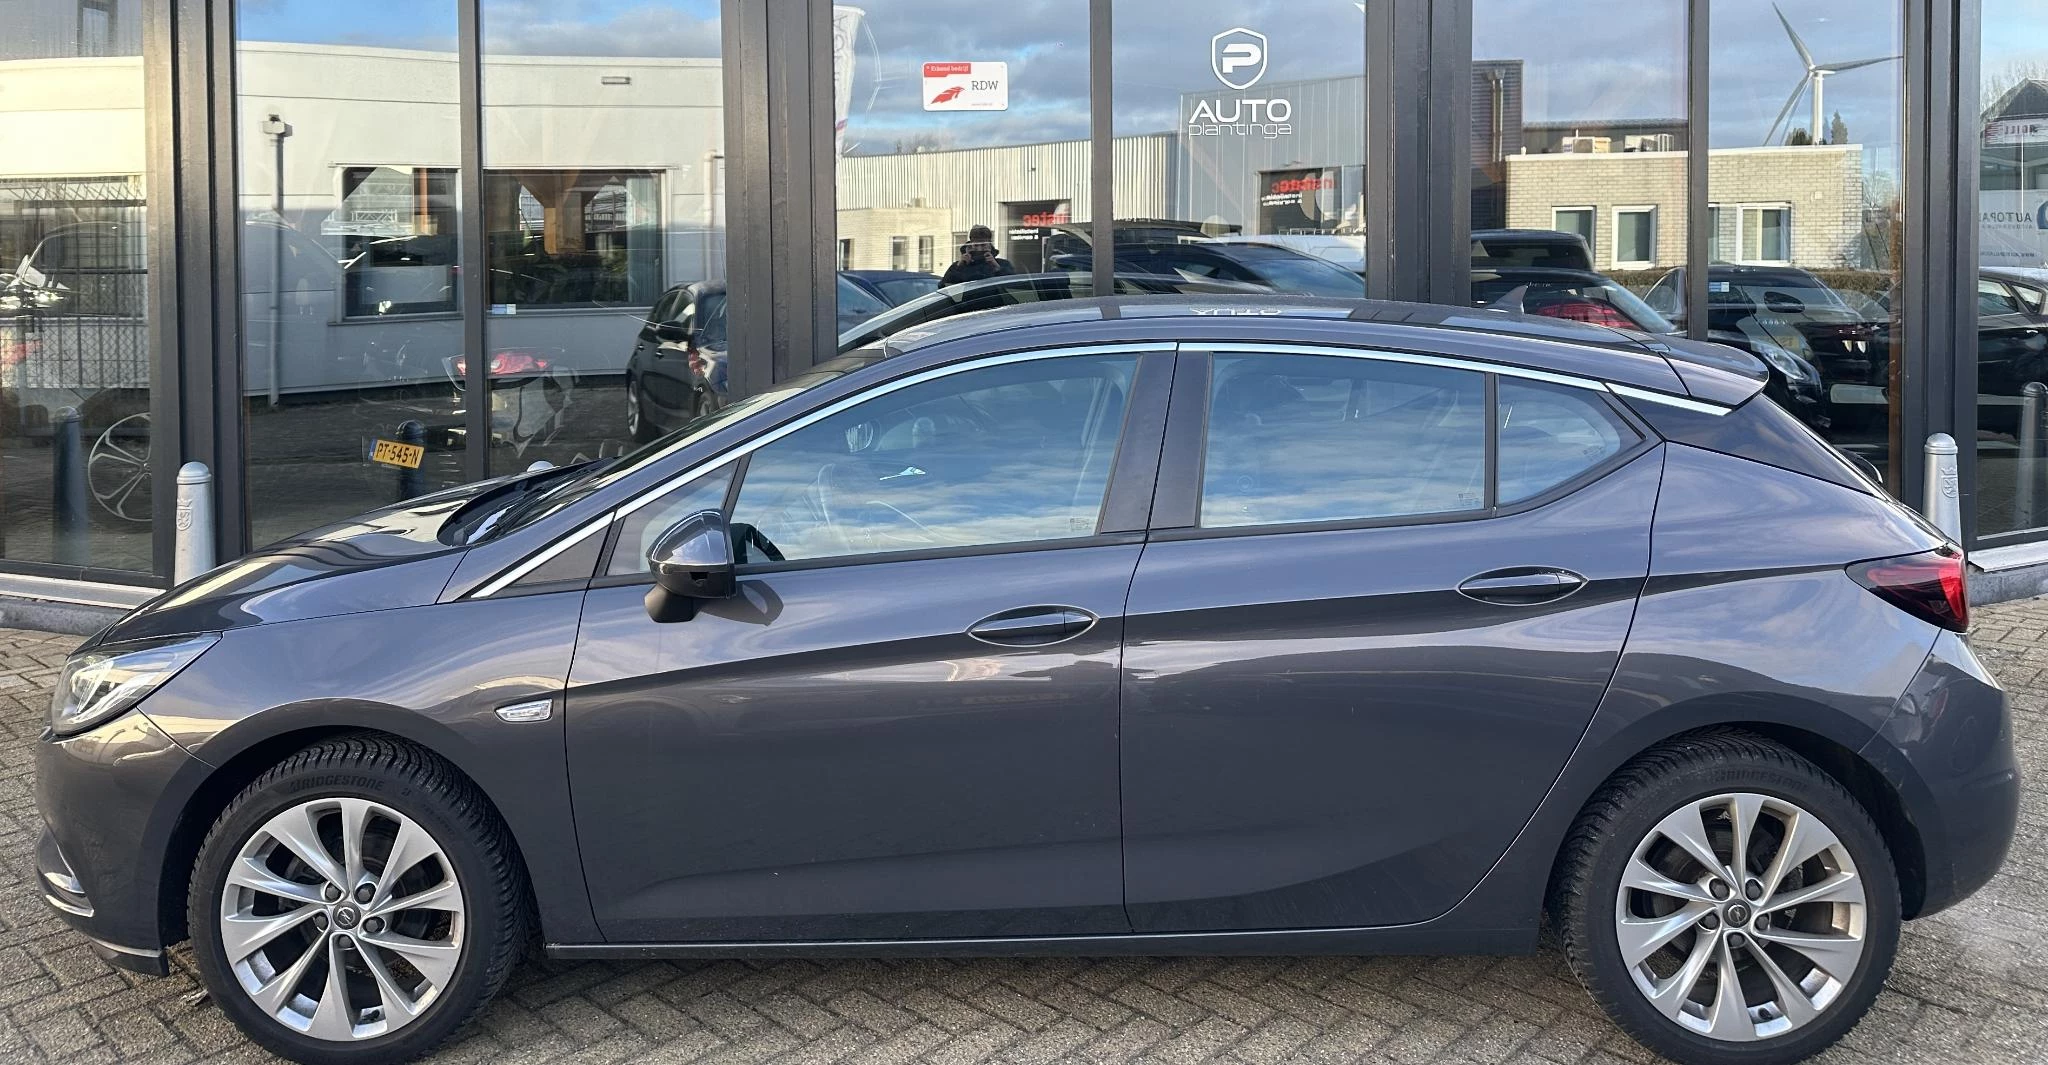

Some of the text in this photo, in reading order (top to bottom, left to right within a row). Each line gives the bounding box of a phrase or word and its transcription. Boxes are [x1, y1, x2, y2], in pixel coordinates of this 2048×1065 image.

[1222, 43, 1262, 74] P
[971, 80, 999, 91] RDW
[1188, 98, 1292, 123] AUTO
[1188, 122, 1292, 141] plantinga
[375, 442, 420, 465] PT-545-N
[289, 775, 385, 793] BRIDGESTONE
